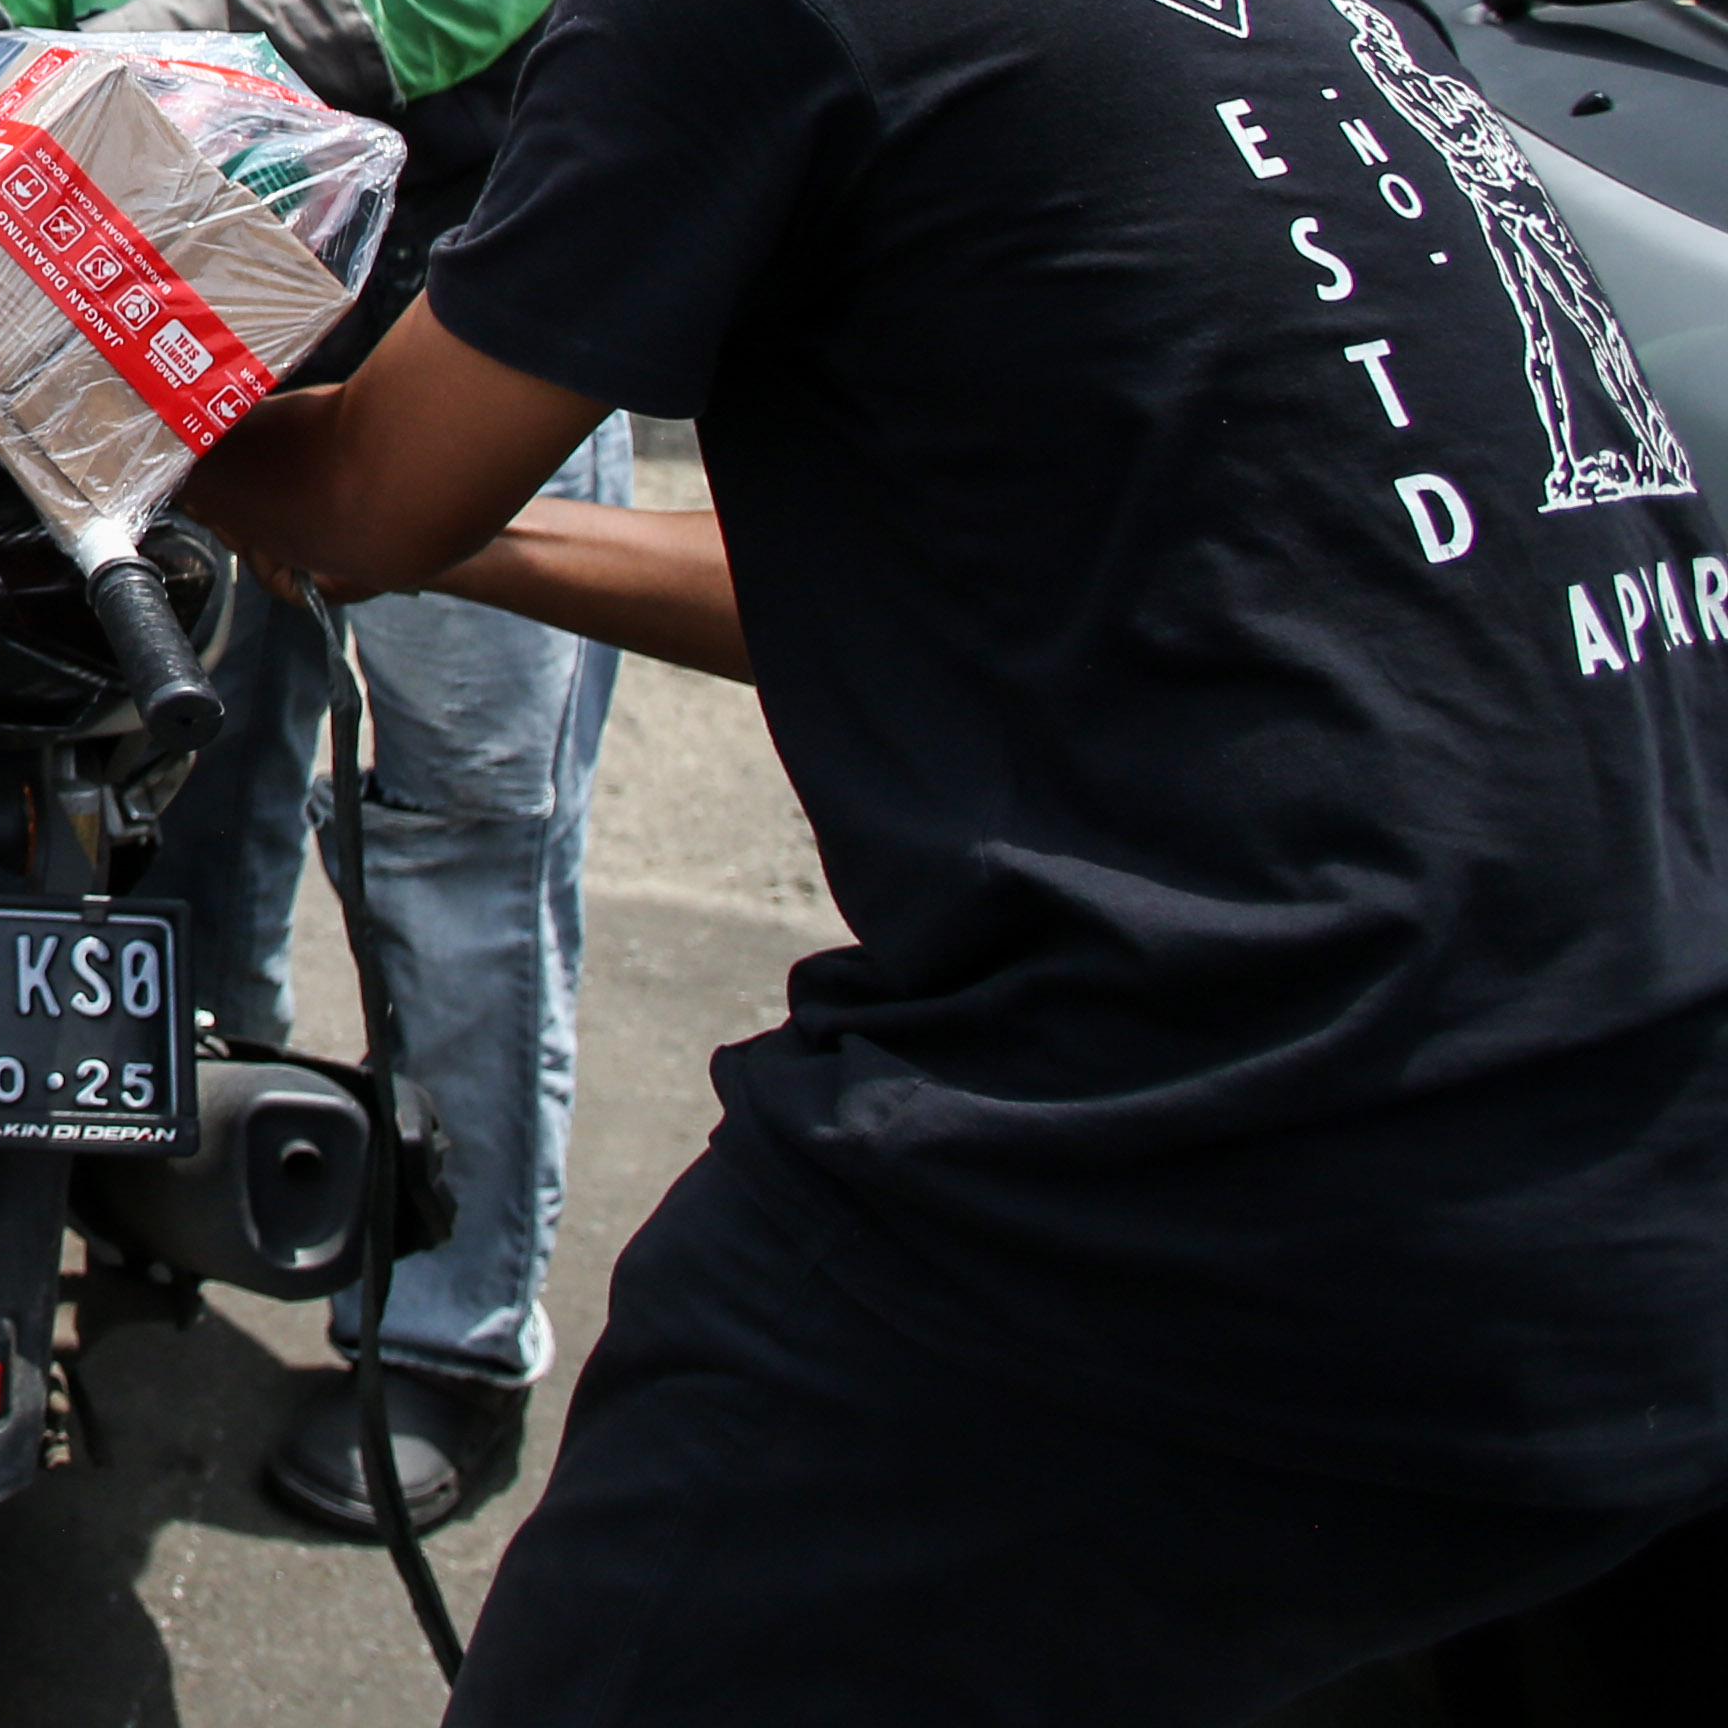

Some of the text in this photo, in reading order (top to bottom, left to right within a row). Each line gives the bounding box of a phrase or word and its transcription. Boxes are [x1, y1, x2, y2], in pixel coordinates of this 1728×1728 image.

[34, 146, 70, 183] BOCOR
[72, 187, 104, 222] PECAH
[101, 217, 136, 256] MUDAH
[134, 255, 173, 296] BARANG
[65, 288, 125, 348] JANGAN
[1216, 99, 1474, 565] ESTD
[153, 333, 199, 380] SECURITY
[174, 332, 201, 360] SEAL
[144, 349, 183, 390] FRAGILE
[82, 1123, 178, 1143] DEPAN
